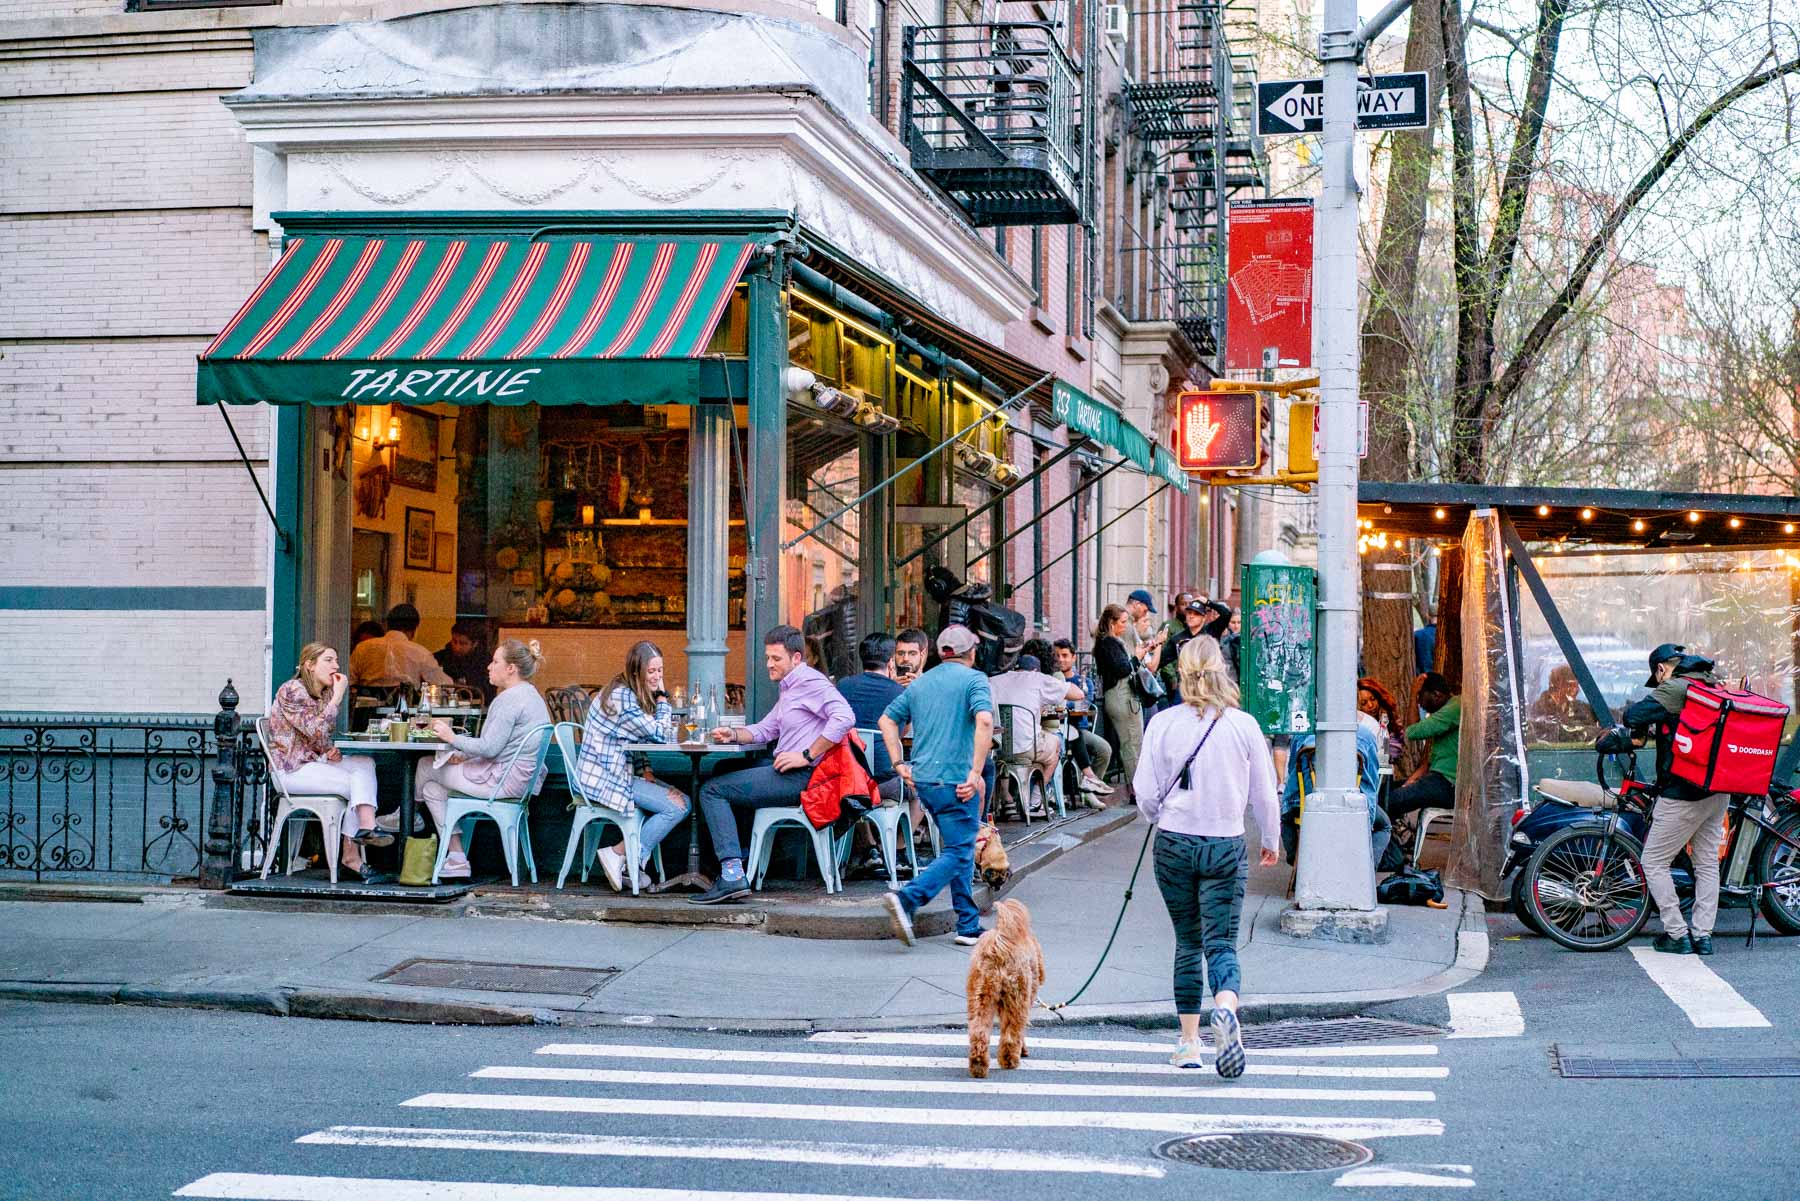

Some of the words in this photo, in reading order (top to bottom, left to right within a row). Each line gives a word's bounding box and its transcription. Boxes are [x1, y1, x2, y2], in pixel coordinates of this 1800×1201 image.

[1358, 92, 1403, 112] WAY
[341, 368, 542, 399] TARTINE
[1057, 389, 1071, 416] 253
[1077, 400, 1103, 432] TARTINE
[1739, 746, 1773, 756] DOORDASH
